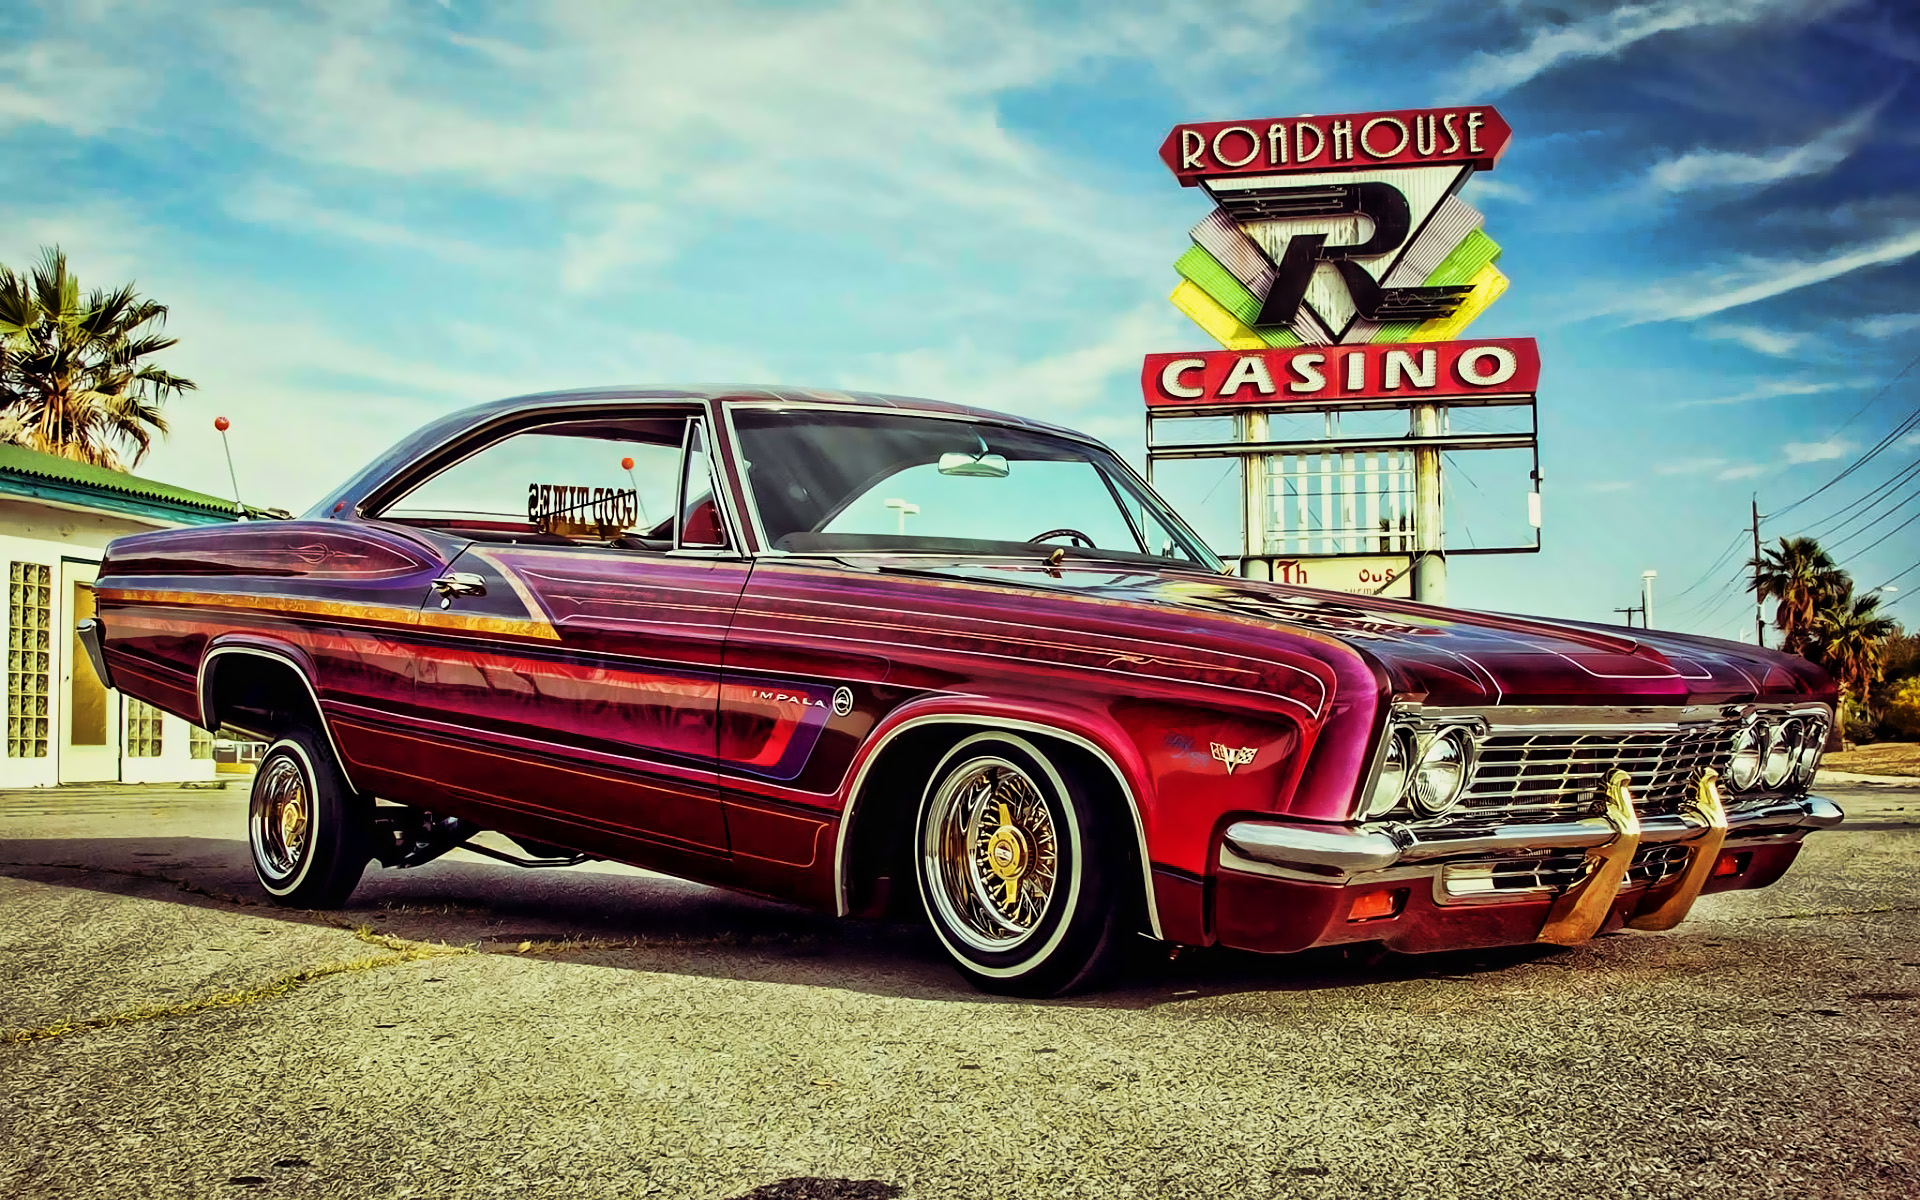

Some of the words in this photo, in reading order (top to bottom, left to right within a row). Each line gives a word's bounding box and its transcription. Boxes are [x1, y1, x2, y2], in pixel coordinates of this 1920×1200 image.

[1181, 111, 1486, 170] ROADHOUSE
[1214, 181, 1477, 327] R
[1161, 346, 1518, 399] CASINO
[751, 689, 829, 710] IMPALA
